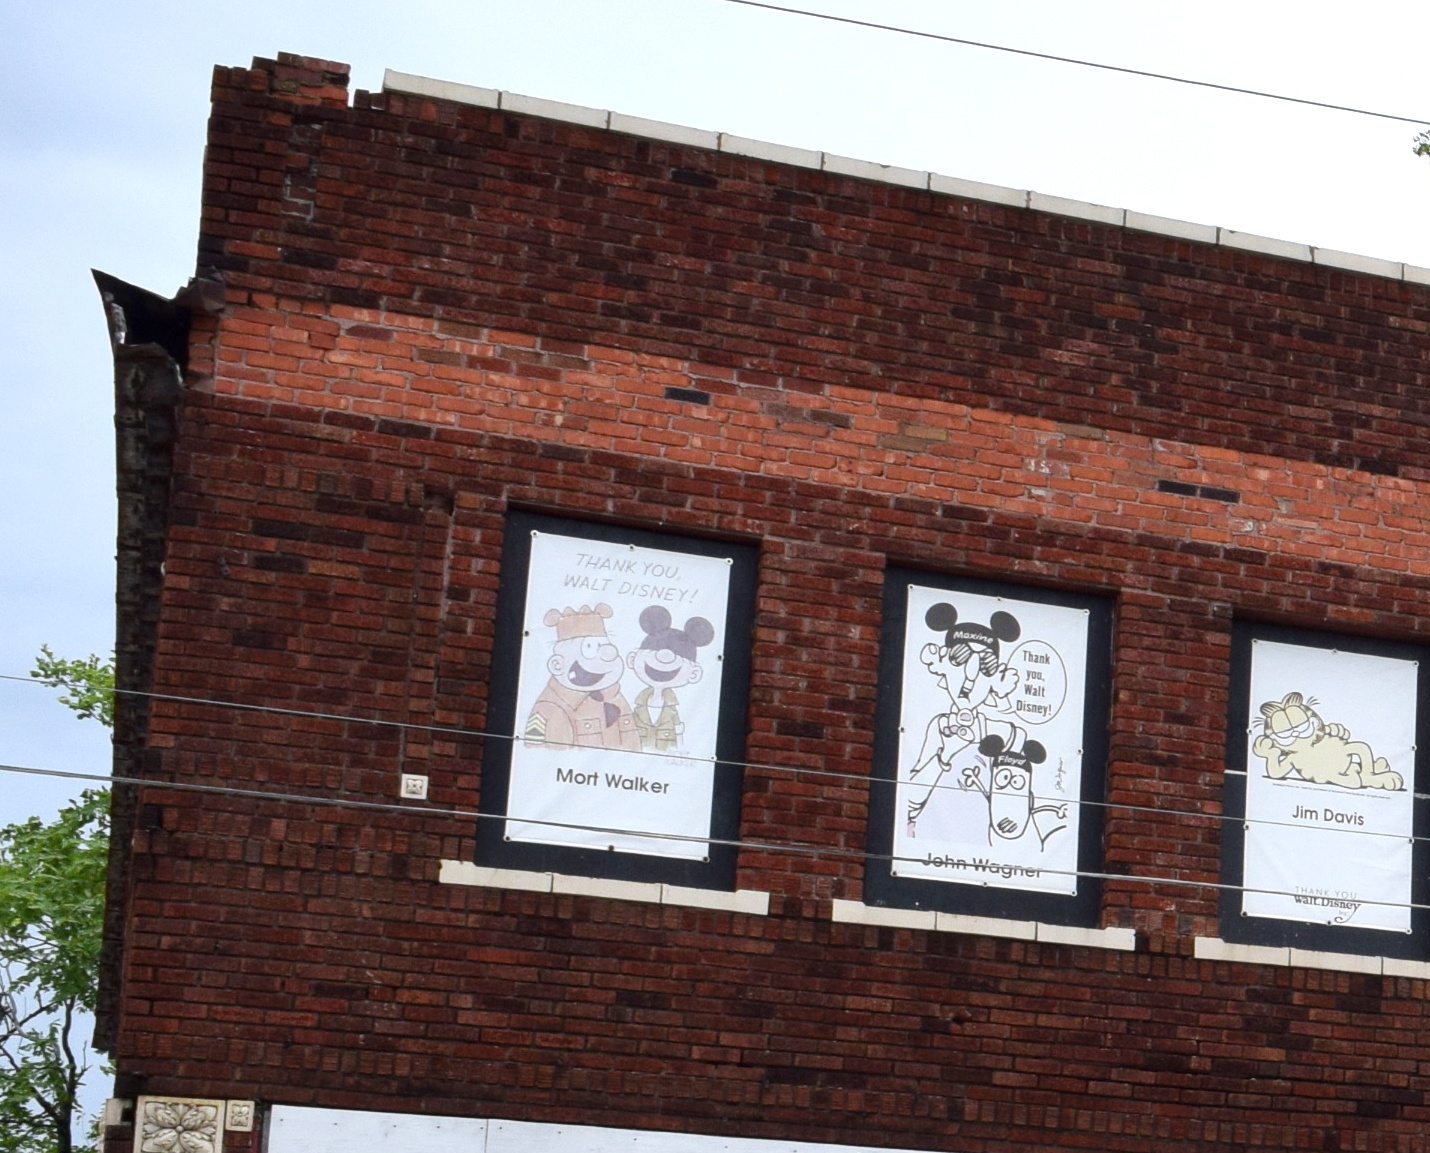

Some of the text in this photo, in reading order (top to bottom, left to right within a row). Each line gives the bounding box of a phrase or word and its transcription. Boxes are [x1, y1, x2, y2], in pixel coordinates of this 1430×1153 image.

[576, 553, 682, 580] THANK YOU,
[564, 573, 699, 603] WALT DISNEY!
[953, 631, 994, 644] Maxine
[1022, 650, 1051, 665] Thank
[1026, 669, 1045, 682] you,
[1024, 684, 1046, 698] Walt
[1016, 700, 1052, 717] Disney!
[997, 755, 1027, 767] Floyd
[555, 767, 670, 794] Mort Walker
[1292, 805, 1365, 826] Jim Davis
[921, 853, 1044, 879] John Wagner
